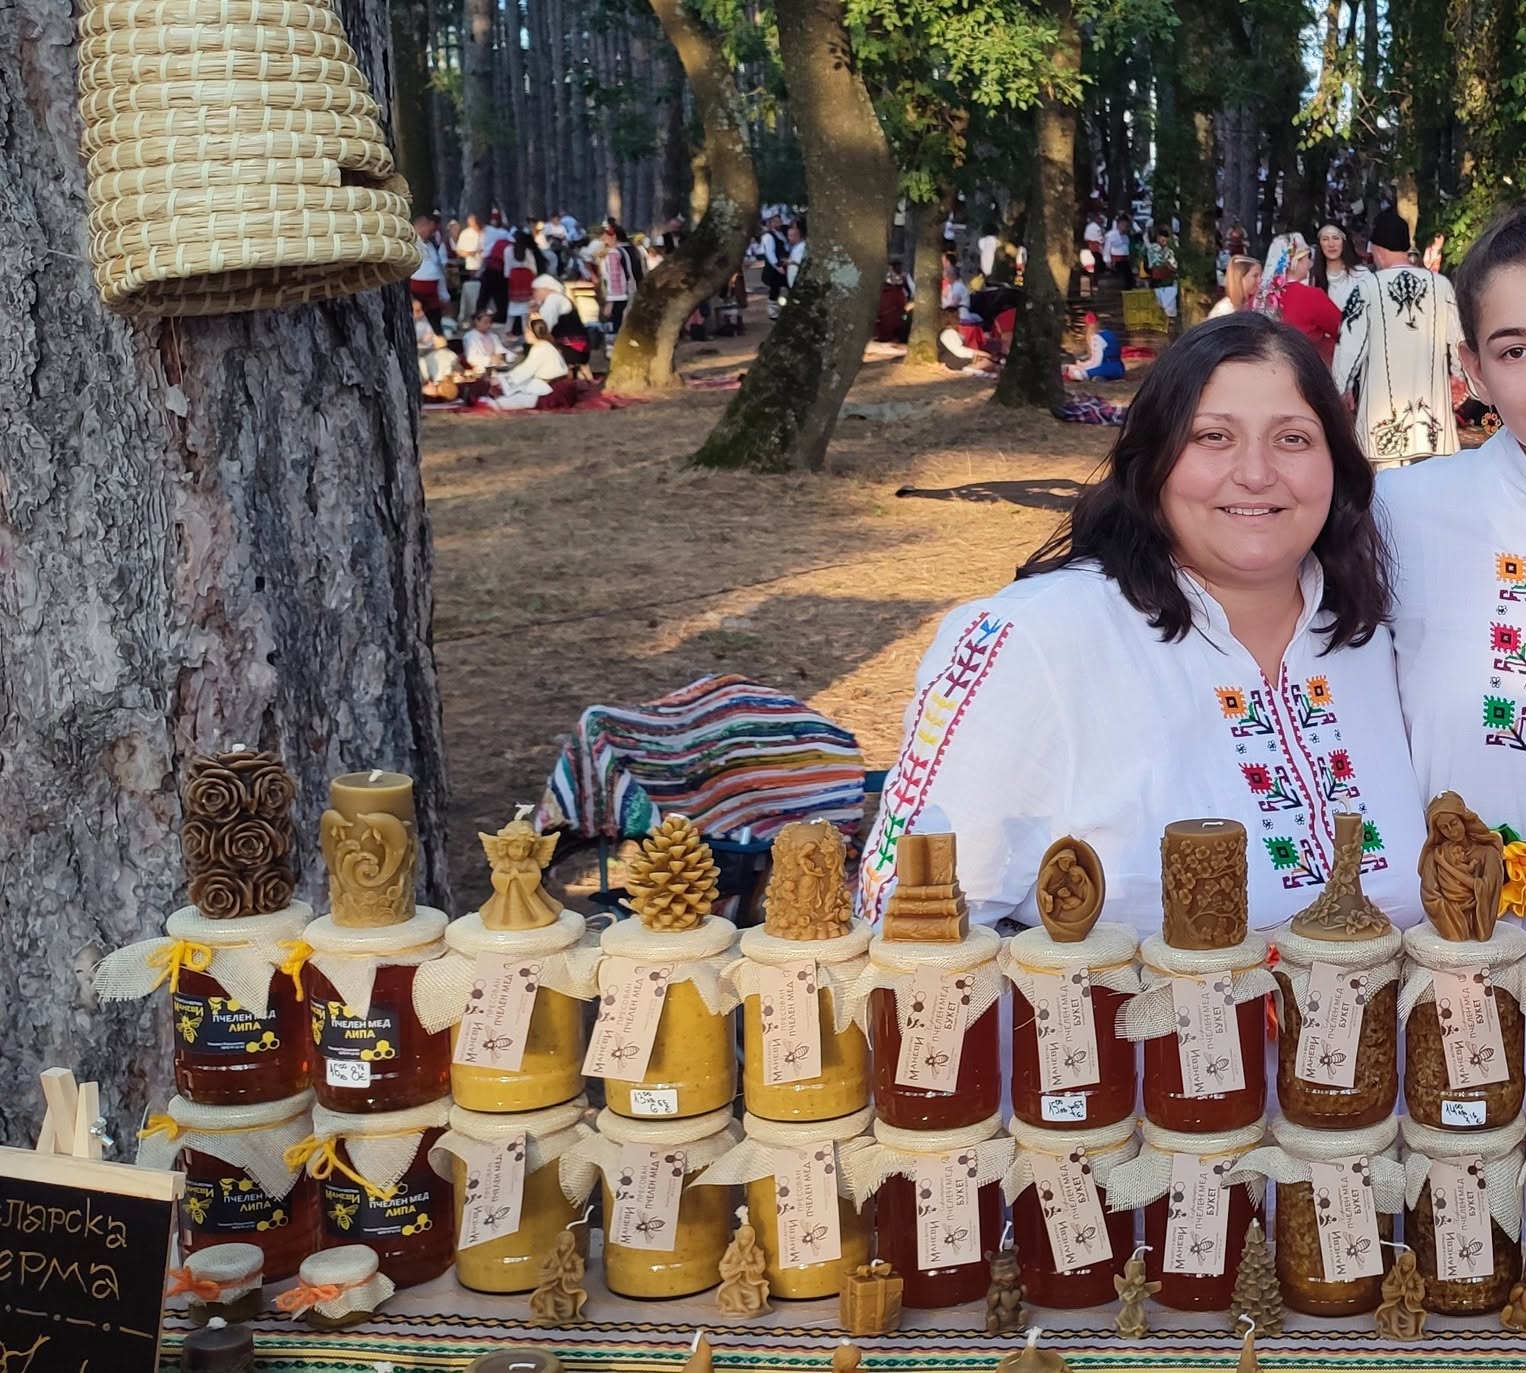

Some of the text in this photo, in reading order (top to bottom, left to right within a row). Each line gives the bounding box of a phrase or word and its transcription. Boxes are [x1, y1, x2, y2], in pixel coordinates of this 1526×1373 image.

[504, 974, 513, 992] МЕД
[212, 1013, 252, 1023] ПЧЕЛЕН
[229, 1022, 261, 1032] ЛИПА
[331, 1019, 391, 1029] ПЧЕЛЕН МЕД
[932, 986, 949, 1042] ПЧЕЛЕН МЕД
[944, 1002, 956, 1030] БУКЕТ
[1060, 985, 1072, 1042] ПЧЕЛЕН МЕД
[1072, 998, 1082, 1026] БУКЕТ
[1202, 993, 1214, 1050] ПЧЕЛЕН МЕД
[1213, 1007, 1223, 1034] БУКЕТ
[1328, 988, 1344, 1039] ПЧЕЛЕН МЕД
[1339, 1002, 1350, 1028] БУКЕТ
[1462, 988, 1476, 1038] ПЧЕЛЕН МЕД
[1474, 1000, 1484, 1024] БУКЕТ
[345, 1030, 376, 1039] ЛИПА
[908, 1036, 924, 1080] МАНЕВИ
[1050, 1042, 1062, 1086] МАНЕВИ
[1190, 1049, 1205, 1092] МАНЕВИ
[1306, 1036, 1320, 1078] МАНЕВИ
[1454, 1040, 1470, 1084] МАНЕВИ
[223, 1193, 263, 1203] ПЧЕЛЕН
[240, 1201, 272, 1212] ЛИПА
[369, 1192, 430, 1209] ПЧЕЛЕН МЕД
[945, 1166, 954, 1220] ПЧЕЛЕН МЕД
[956, 1179, 964, 1206] БУКЕТ
[1060, 1164, 1080, 1220] ПЧЕЛЕН МЕД
[1072, 1176, 1086, 1204] БУКЕТ
[1196, 1173, 1208, 1229] ПЧЕЛЕН МЕД
[1207, 1188, 1216, 1216] БУКЕТ
[1352, 1189, 1361, 1214] БУКЕТ
[1457, 1178, 1468, 1230] ПЧЕЛЕН МЕД
[1467, 1191, 1476, 1216] БУКЕТ
[0, 1197, 127, 1249] ларска
[385, 1205, 416, 1217] ЛИПА
[1344, 1196, 1354, 1228] ПЧЕЛЕН
[930, 1220, 941, 1262] МАНЕВИ
[1058, 1221, 1077, 1264] МАНЕВИ
[1175, 1226, 1188, 1269] МАНЕВИ
[1332, 1231, 1346, 1275] МАНЕВИ
[1446, 1232, 1457, 1276] МАНЕВИ
